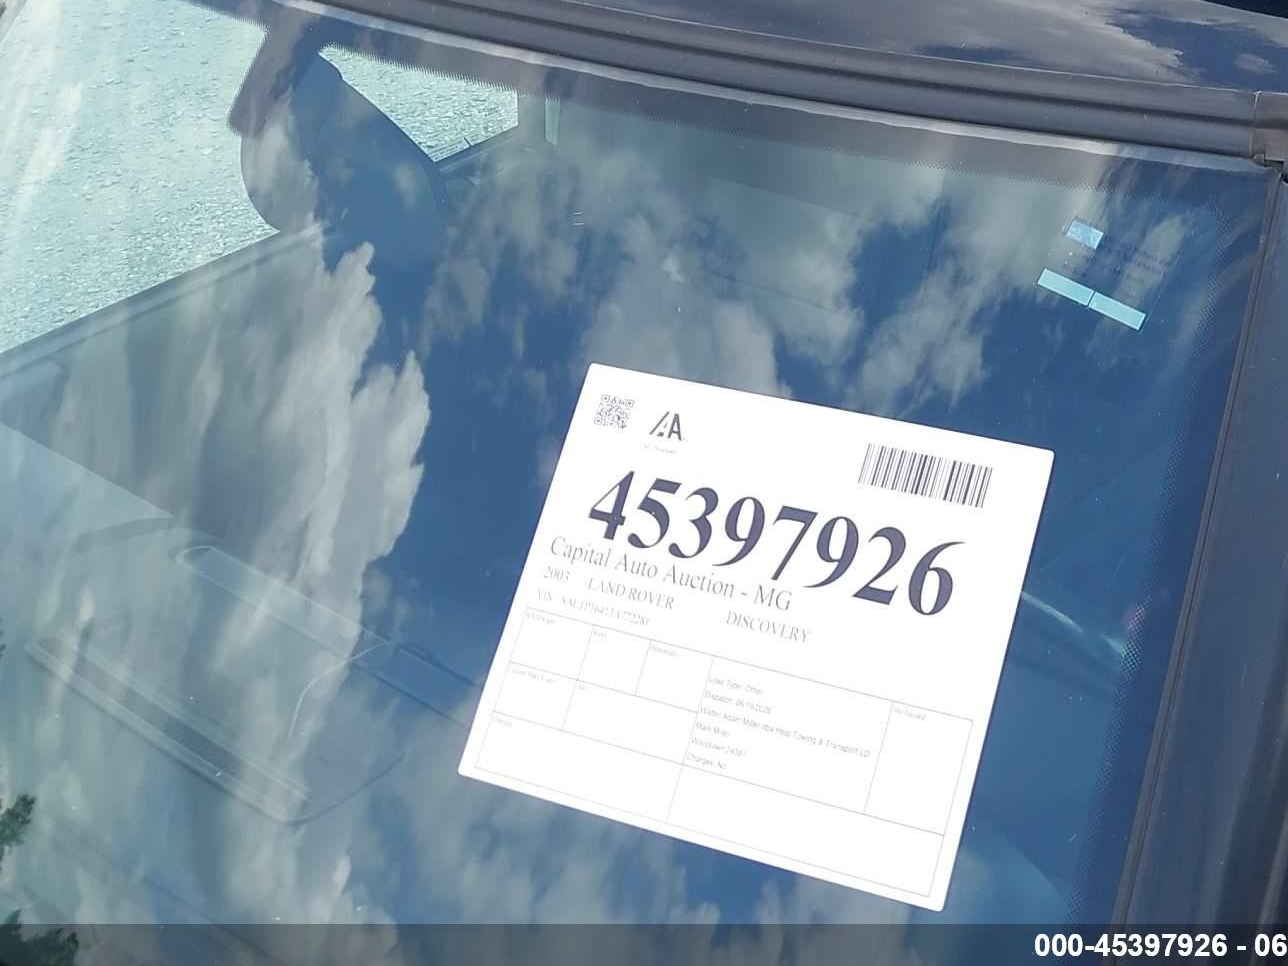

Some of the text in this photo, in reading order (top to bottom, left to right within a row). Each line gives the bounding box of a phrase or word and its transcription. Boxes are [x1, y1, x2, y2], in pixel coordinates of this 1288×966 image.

[546, 534, 612, 572] Capital
[613, 551, 661, 579] Auto
[661, 562, 737, 598] Auction
[752, 585, 793, 611] MG
[588, 471, 964, 616] 45397926
[542, 564, 811, 644] 2003 LAND ROVER DISCOVERY
